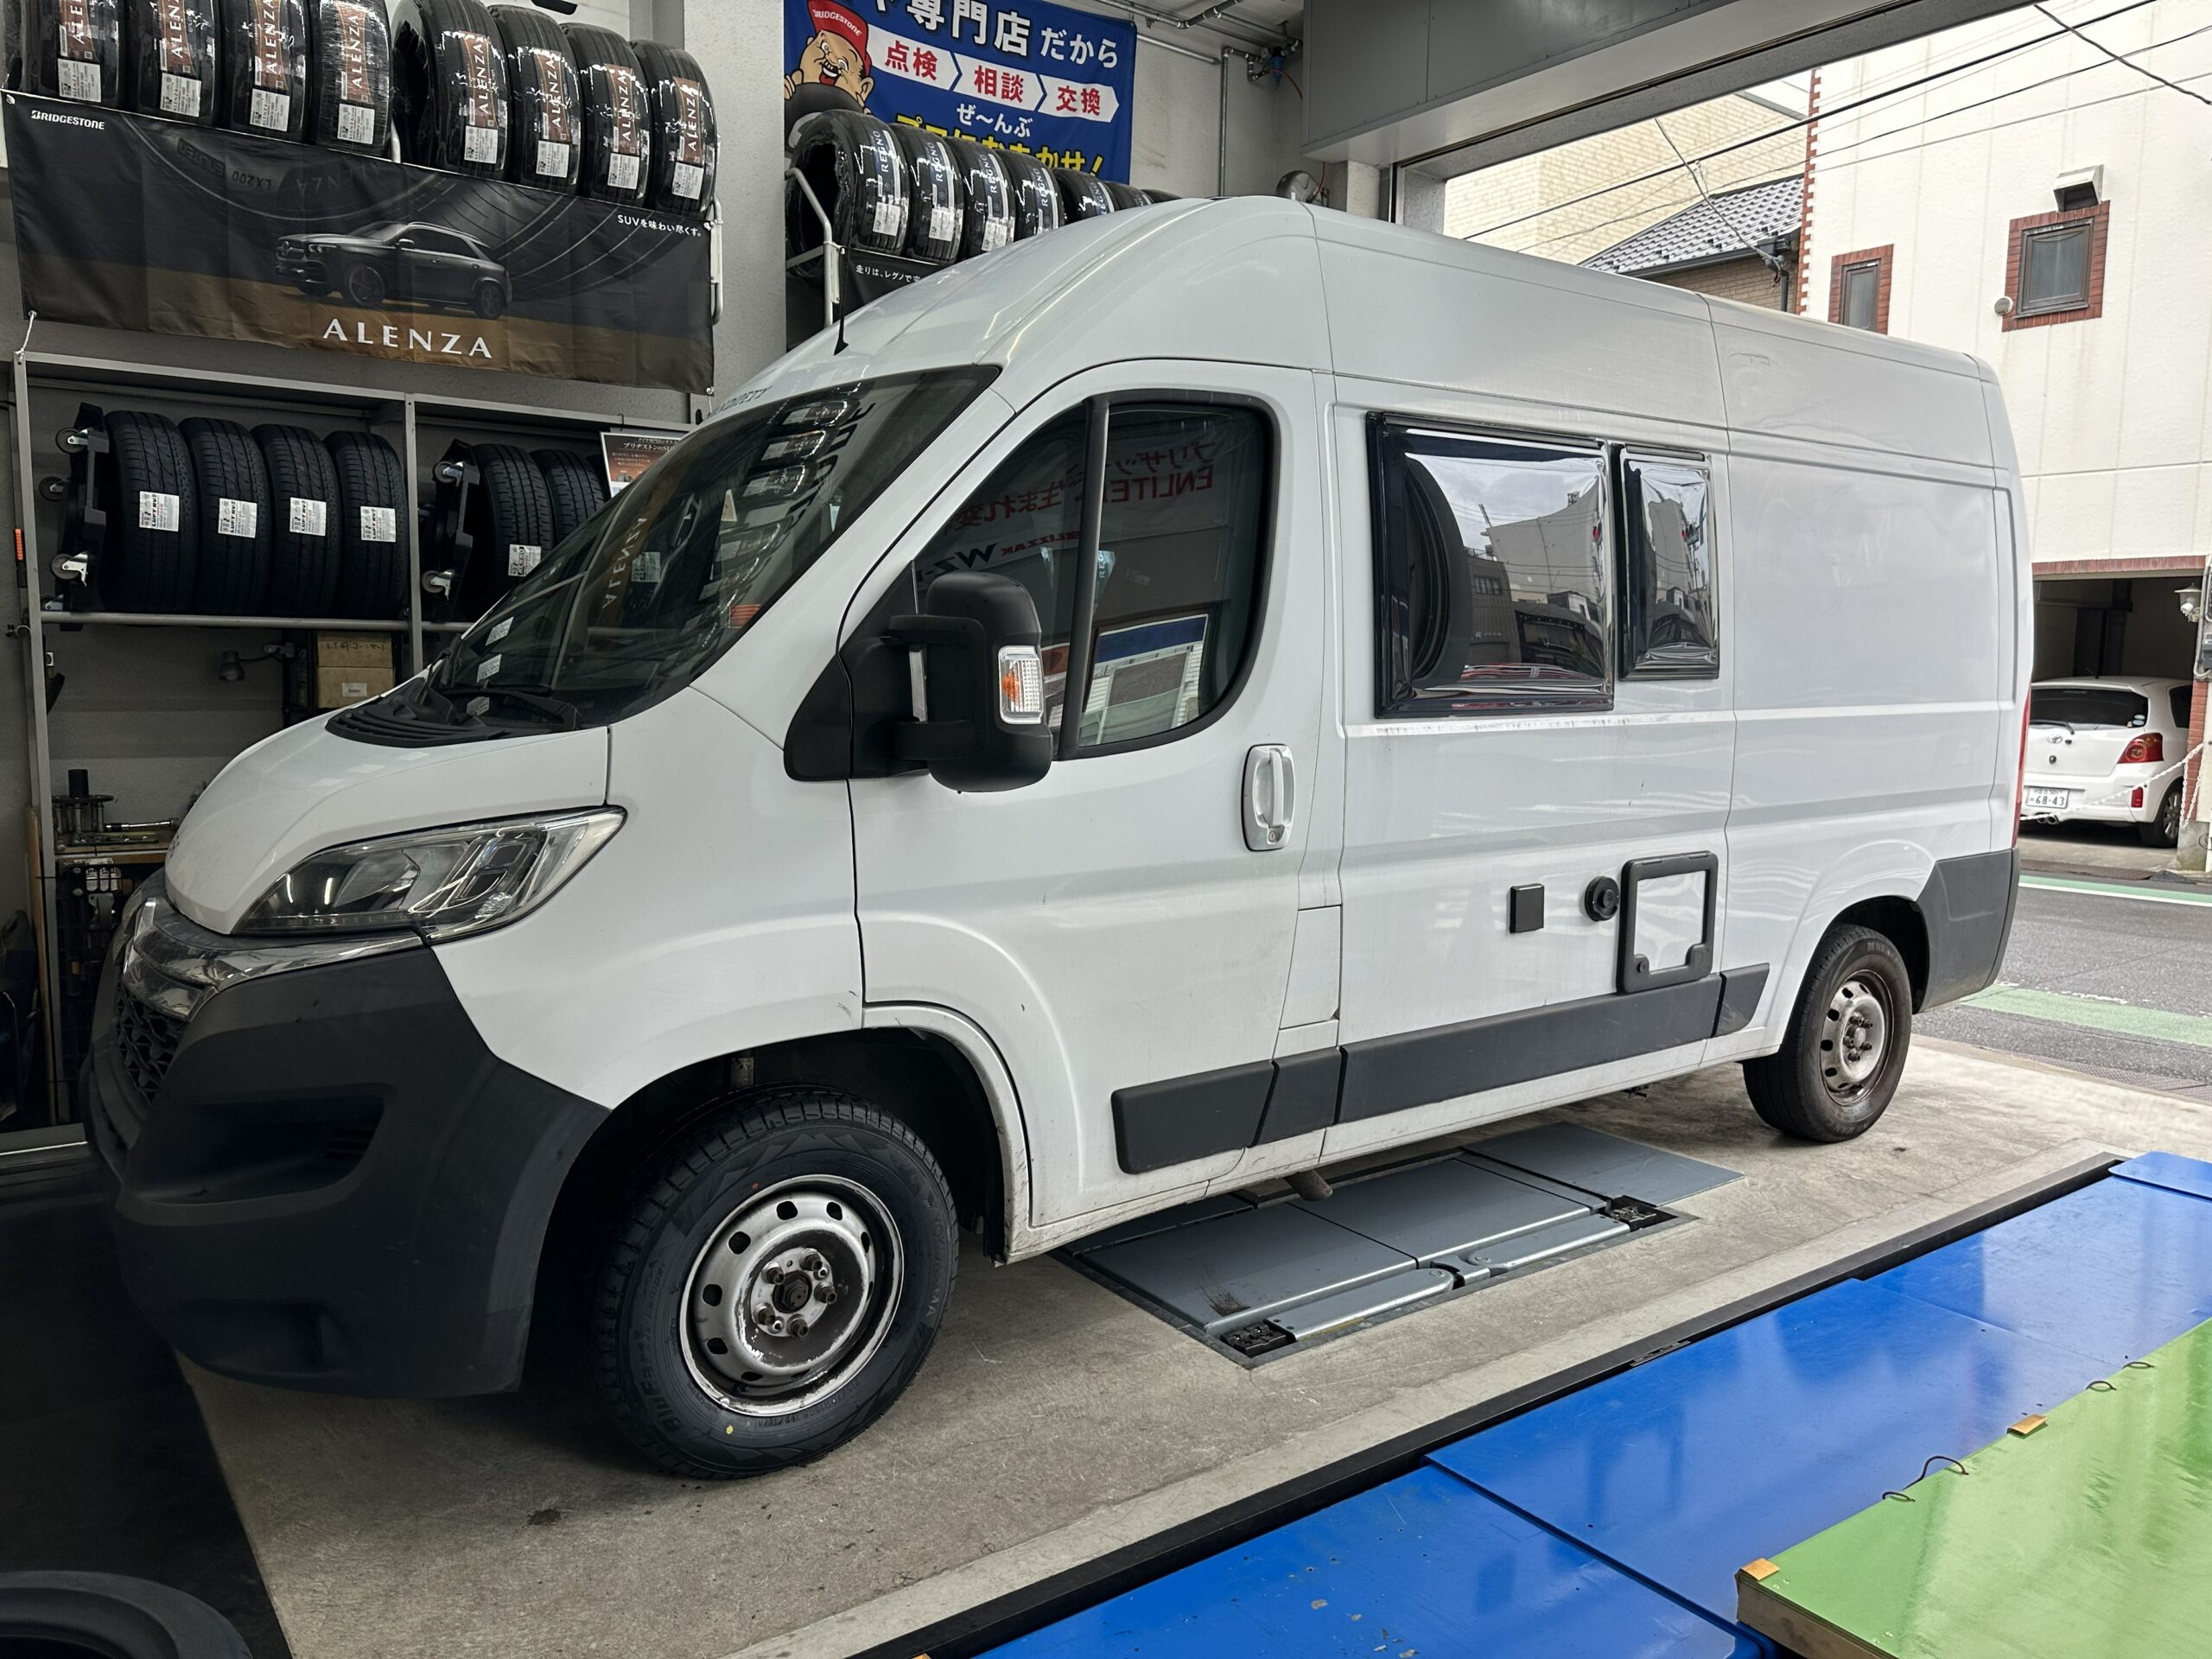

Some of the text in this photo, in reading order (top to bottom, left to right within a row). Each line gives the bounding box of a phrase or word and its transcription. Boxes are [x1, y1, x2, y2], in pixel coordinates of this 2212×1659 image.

[70, 0, 85, 44] ALE
[168, 0, 183, 59] ALEN
[812, 9, 862, 37] BRIDGESTONE
[875, 0, 1118, 68] 専門店 だから
[346, 15, 363, 89] ALENZA
[885, 40, 938, 80] 点検
[473, 43, 489, 115] ALENZA
[974, 65, 1024, 104] 相談
[31, 110, 105, 130] BRIDGESTONE
[1056, 86, 1101, 116] 交換
[873, 130, 889, 173] REGNO
[926, 141, 944, 182] REGNO
[979, 154, 998, 194] REGNO
[323, 318, 492, 359] ALENZA
[2035, 795, 2065, 806] 68-43
